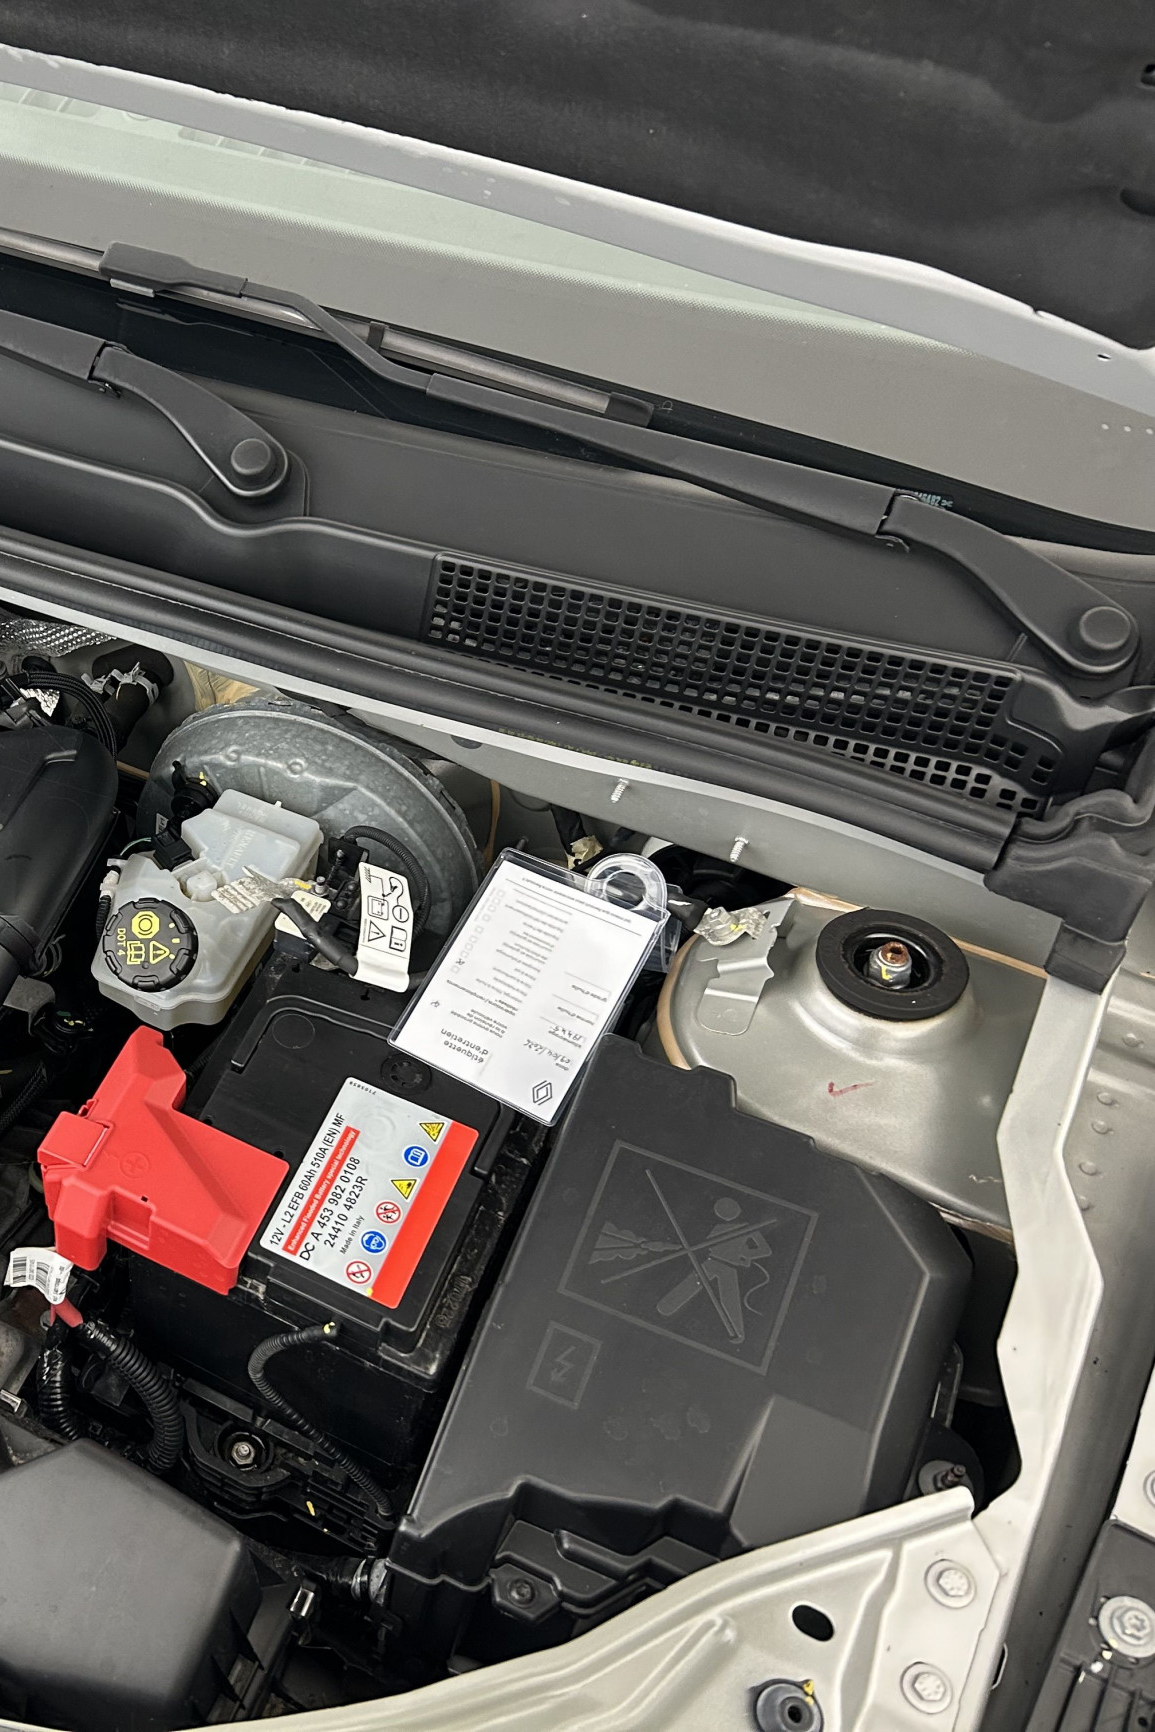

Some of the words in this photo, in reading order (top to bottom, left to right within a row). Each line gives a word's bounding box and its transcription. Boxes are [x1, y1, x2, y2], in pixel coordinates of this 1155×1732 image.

[117, 927, 125, 946] DOT
[439, 1028, 489, 1057] d'entretien
[442, 1038, 485, 1064] étiquette
[268, 1226, 285, 1247] 12V
[280, 1209, 294, 1224] L2
[287, 1190, 304, 1211] EFB
[297, 1167, 317, 1192] 60Ah
[310, 1144, 329, 1168] 510A
[321, 1126, 340, 1148] (EN)
[331, 1112, 346, 1127] MF
[338, 1155, 360, 1184] 0108
[287, 1220, 308, 1251] Enhanced
[302, 1197, 319, 1222] Flooded
[314, 1178, 330, 1200] Battery
[324, 1158, 341, 1180] special
[334, 1128, 356, 1160] technology
[327, 1183, 346, 1206] 982
[315, 1206, 334, 1229] 453
[322, 1212, 349, 1248] 24410
[341, 1174, 368, 1212] 4823R
[310, 1229, 322, 1241] A
[338, 1235, 353, 1254] Made
[352, 1214, 365, 1230] Italy
